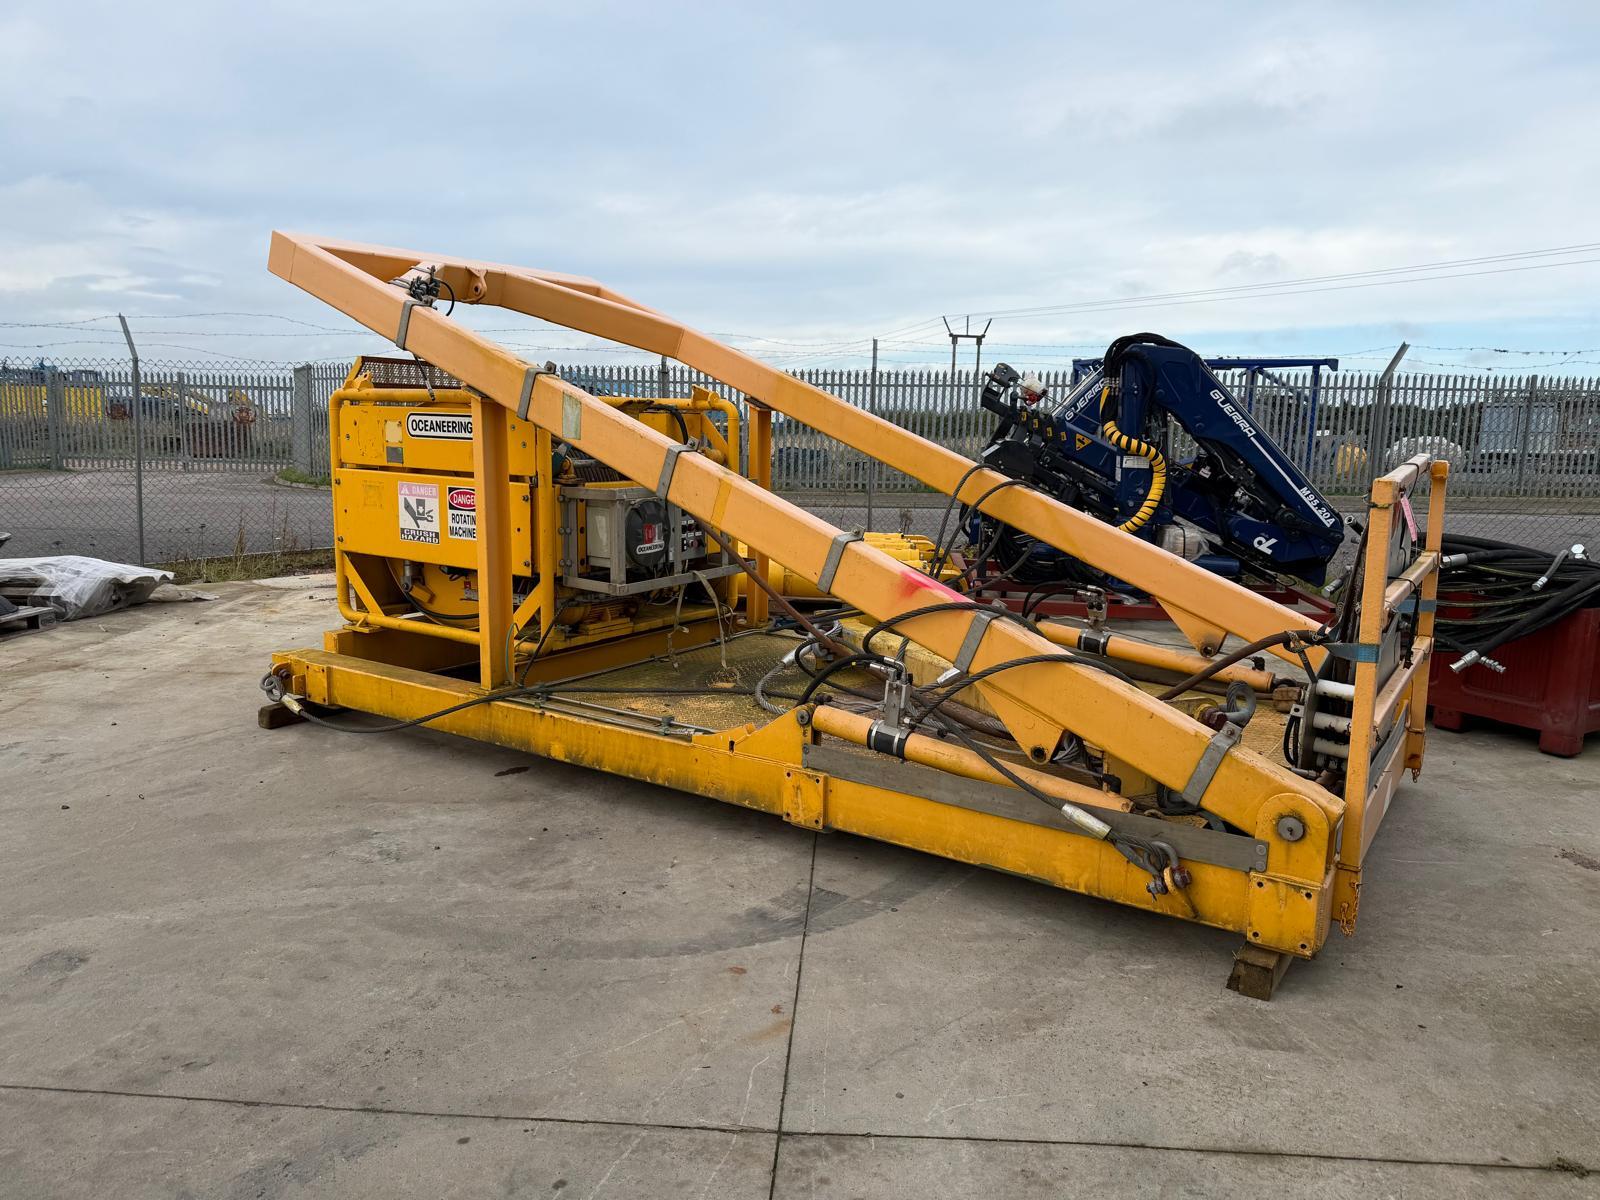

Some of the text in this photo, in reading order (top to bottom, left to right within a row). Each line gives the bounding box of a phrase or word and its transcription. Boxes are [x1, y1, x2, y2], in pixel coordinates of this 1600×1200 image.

[1209, 389, 1257, 437] GUERRA
[411, 419, 473, 434] OCEANEERING
[412, 485, 437, 497] DANGER
[453, 493, 475, 505] DANGE
[1299, 486, 1336, 528] M95.20A
[451, 513, 476, 525] ROTATIN
[404, 529, 436, 538] CRUSH
[449, 526, 476, 538] MACHINE
[401, 534, 439, 544] HAZARD
